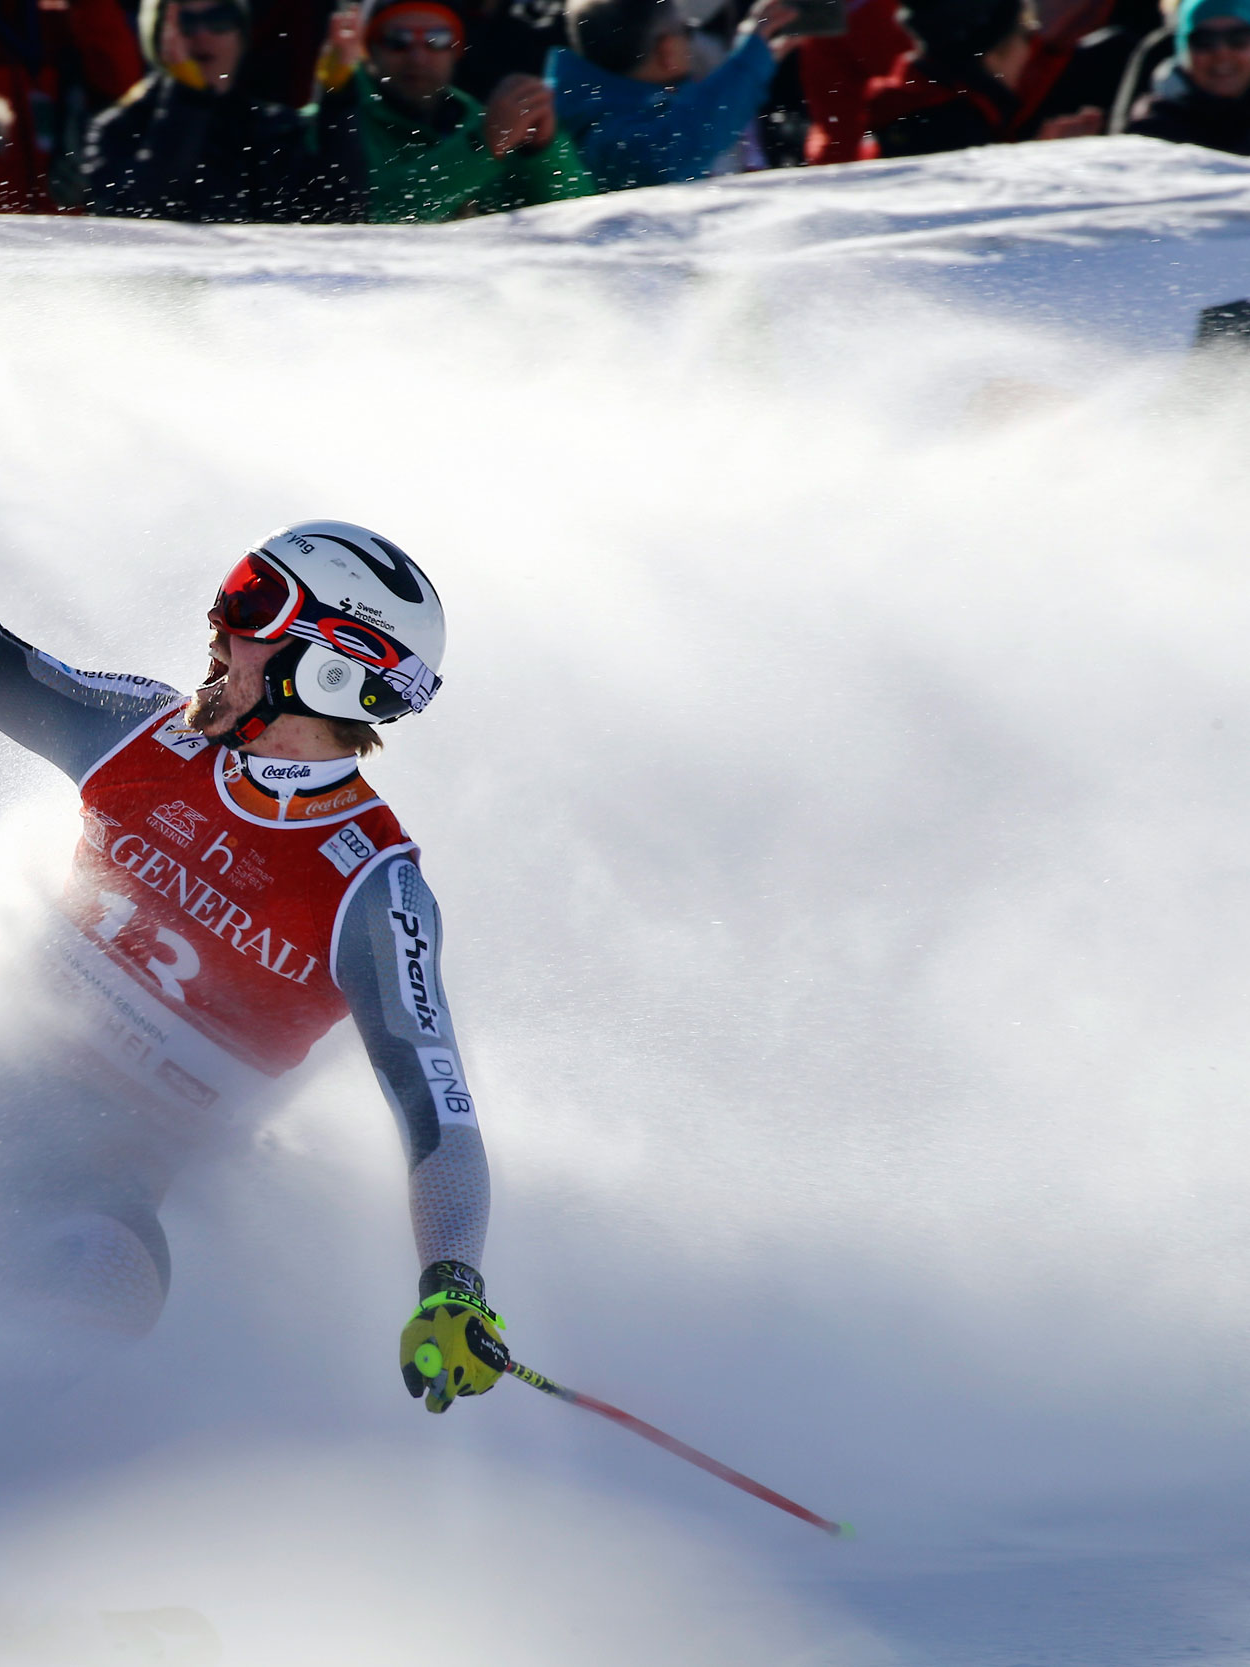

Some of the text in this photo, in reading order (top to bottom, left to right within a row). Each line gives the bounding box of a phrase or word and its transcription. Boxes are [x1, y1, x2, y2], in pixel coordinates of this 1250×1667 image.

[354, 610, 395, 632] Protection
[357, 602, 383, 617] Sweet
[145, 816, 191, 849] GENERALI
[110, 833, 320, 986] GENERALI
[428, 1058, 472, 1113] DNB
